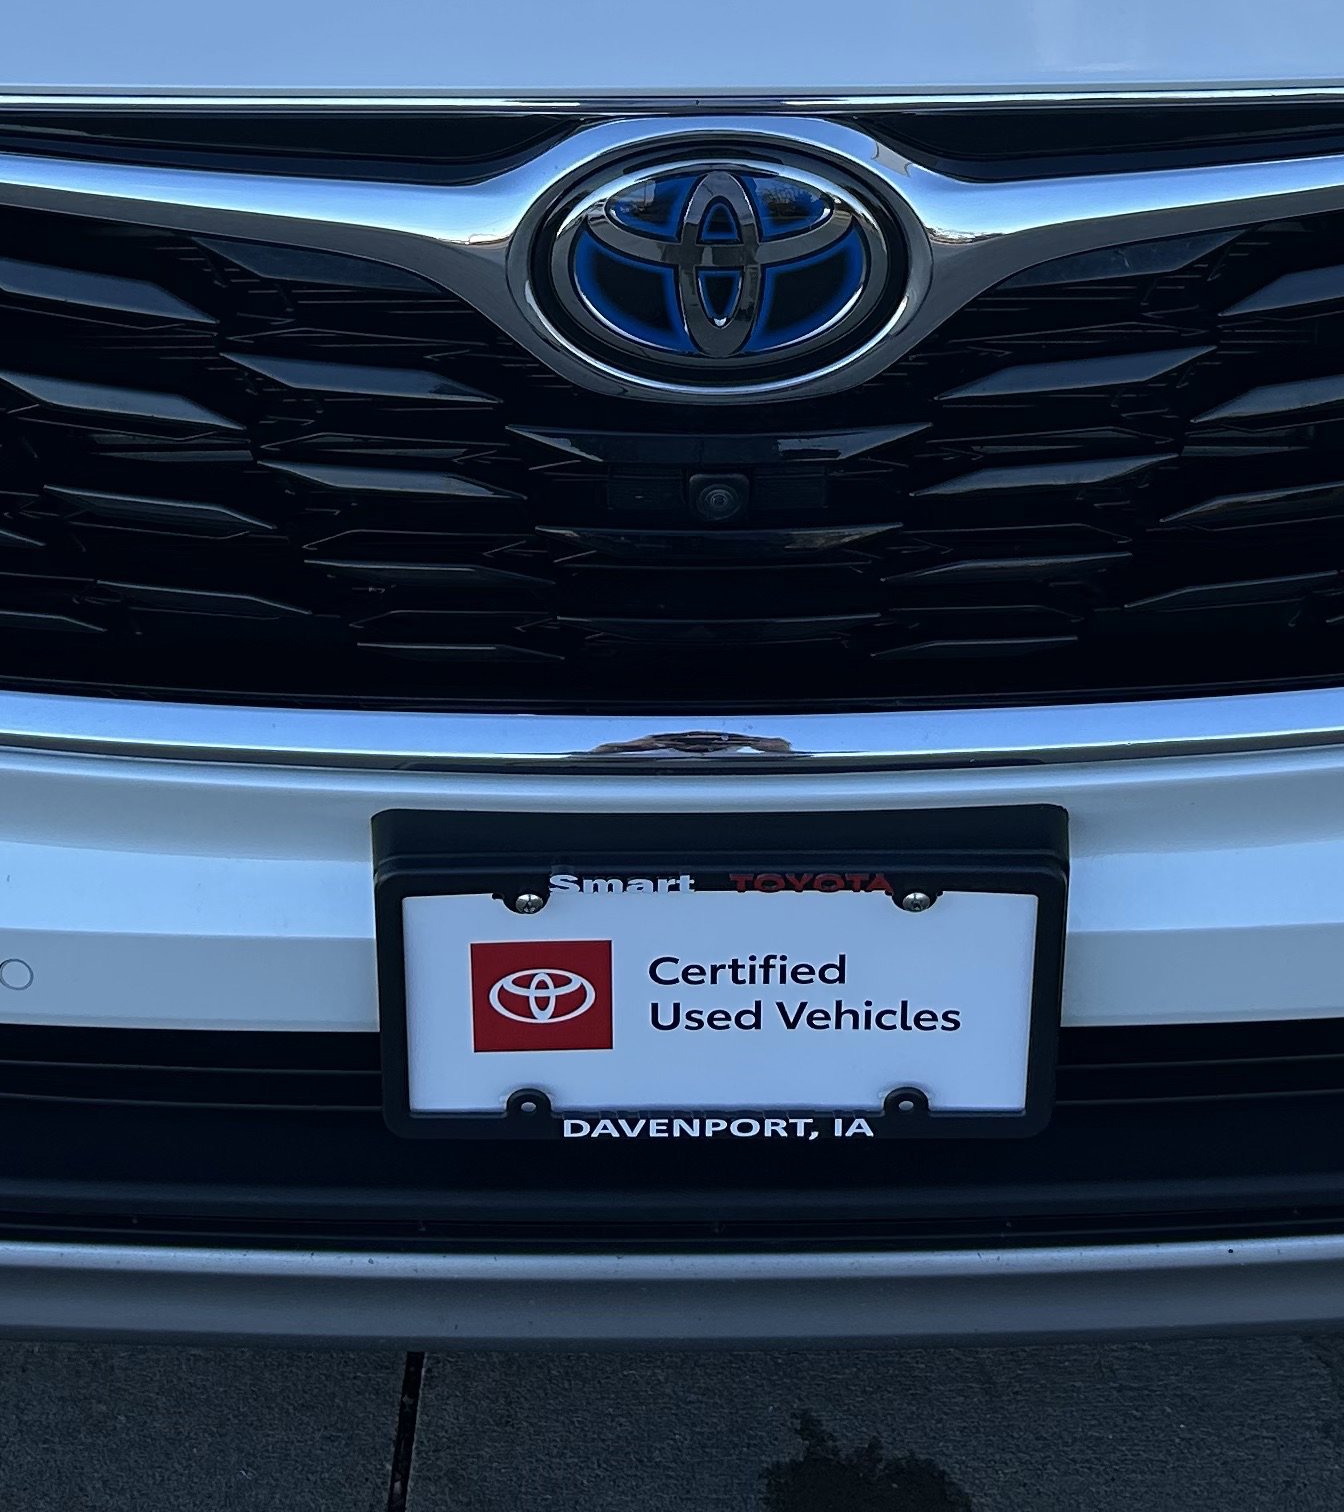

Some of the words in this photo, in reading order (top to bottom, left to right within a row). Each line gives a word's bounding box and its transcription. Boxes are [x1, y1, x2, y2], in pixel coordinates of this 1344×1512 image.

[549, 874, 695, 894] Smart
[729, 873, 894, 895] TOYOTA
[648, 953, 846, 985] Certified
[650, 1000, 762, 1031] Used
[775, 1000, 961, 1031] Vehicles
[563, 1118, 819, 1141] DAVENPORT,
[834, 1118, 874, 1137] IA
